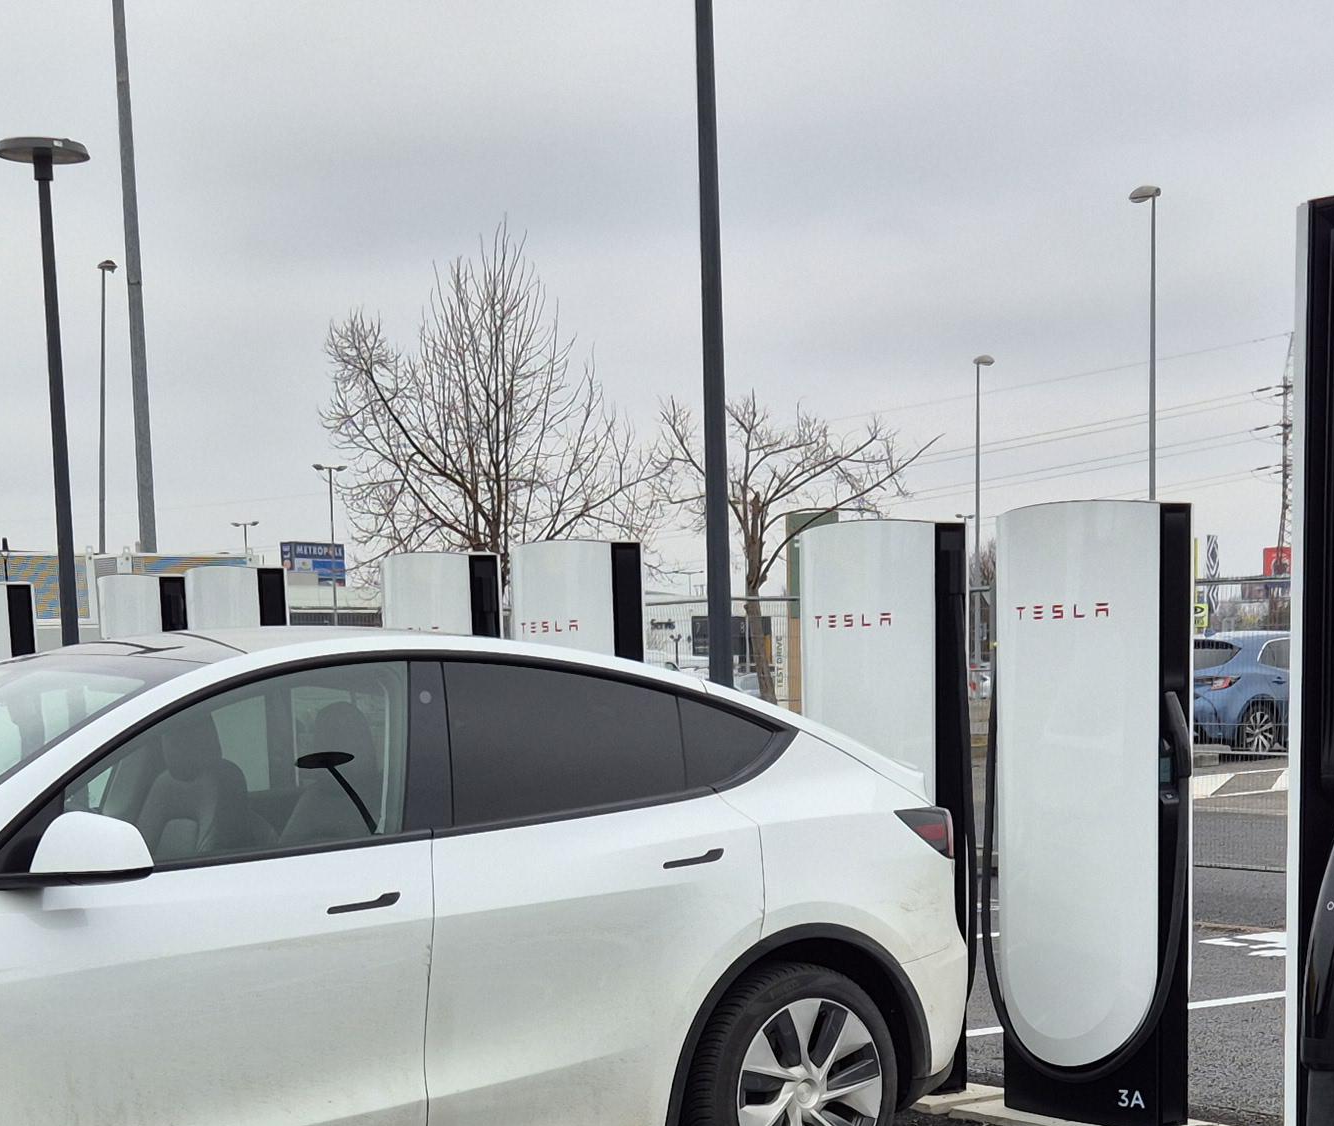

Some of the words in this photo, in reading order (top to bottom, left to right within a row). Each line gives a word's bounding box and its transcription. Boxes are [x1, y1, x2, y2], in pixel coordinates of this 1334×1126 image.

[1015, 602, 1109, 620] TESLA
[521, 619, 579, 634] TESLA
[814, 612, 892, 629] TESLA
[1117, 1089, 1145, 1109] 3A
